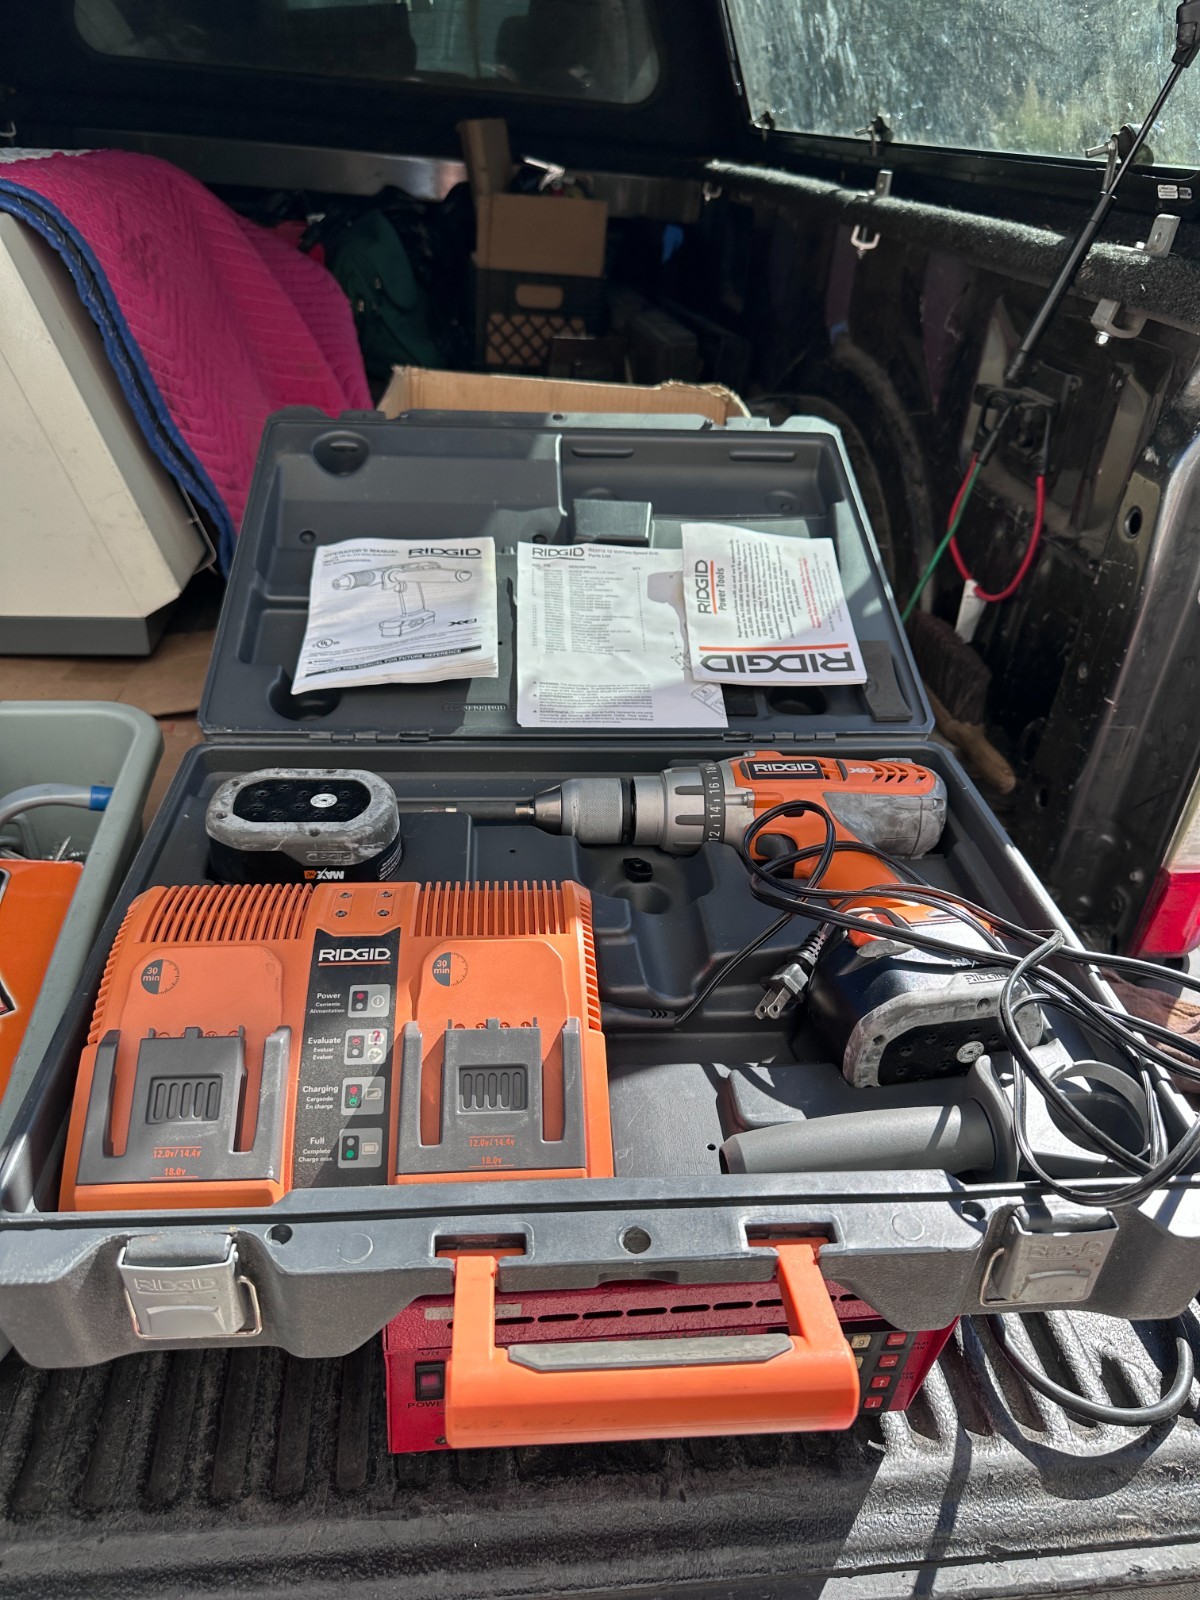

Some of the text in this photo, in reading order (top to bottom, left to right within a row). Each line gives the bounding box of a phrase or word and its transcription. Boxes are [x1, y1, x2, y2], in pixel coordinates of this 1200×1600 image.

[408, 547, 482, 556] RIDGID
[532, 547, 585, 557] RIDGID
[694, 559, 713, 614] RIDGID
[716, 567, 728, 611] Power Tools
[700, 652, 856, 673] RIDGID
[706, 766, 717, 774] 18
[753, 764, 817, 772] RIDGID
[709, 783, 720, 794] 16
[710, 806, 721, 818] 14
[708, 831, 720, 841] 12
[316, 867, 345, 880] MAX
[318, 948, 391, 961] RIDGID
[147, 966, 159, 975] 30
[142, 973, 160, 982] min
[307, 1036, 342, 1044] Evaluate
[302, 1085, 339, 1094] Charging
[310, 1137, 325, 1145] Full
[164, 1167, 186, 1176] 18.0v
[134, 1279, 217, 1291] RIDGID
[407, 1401, 444, 1409] POWE
